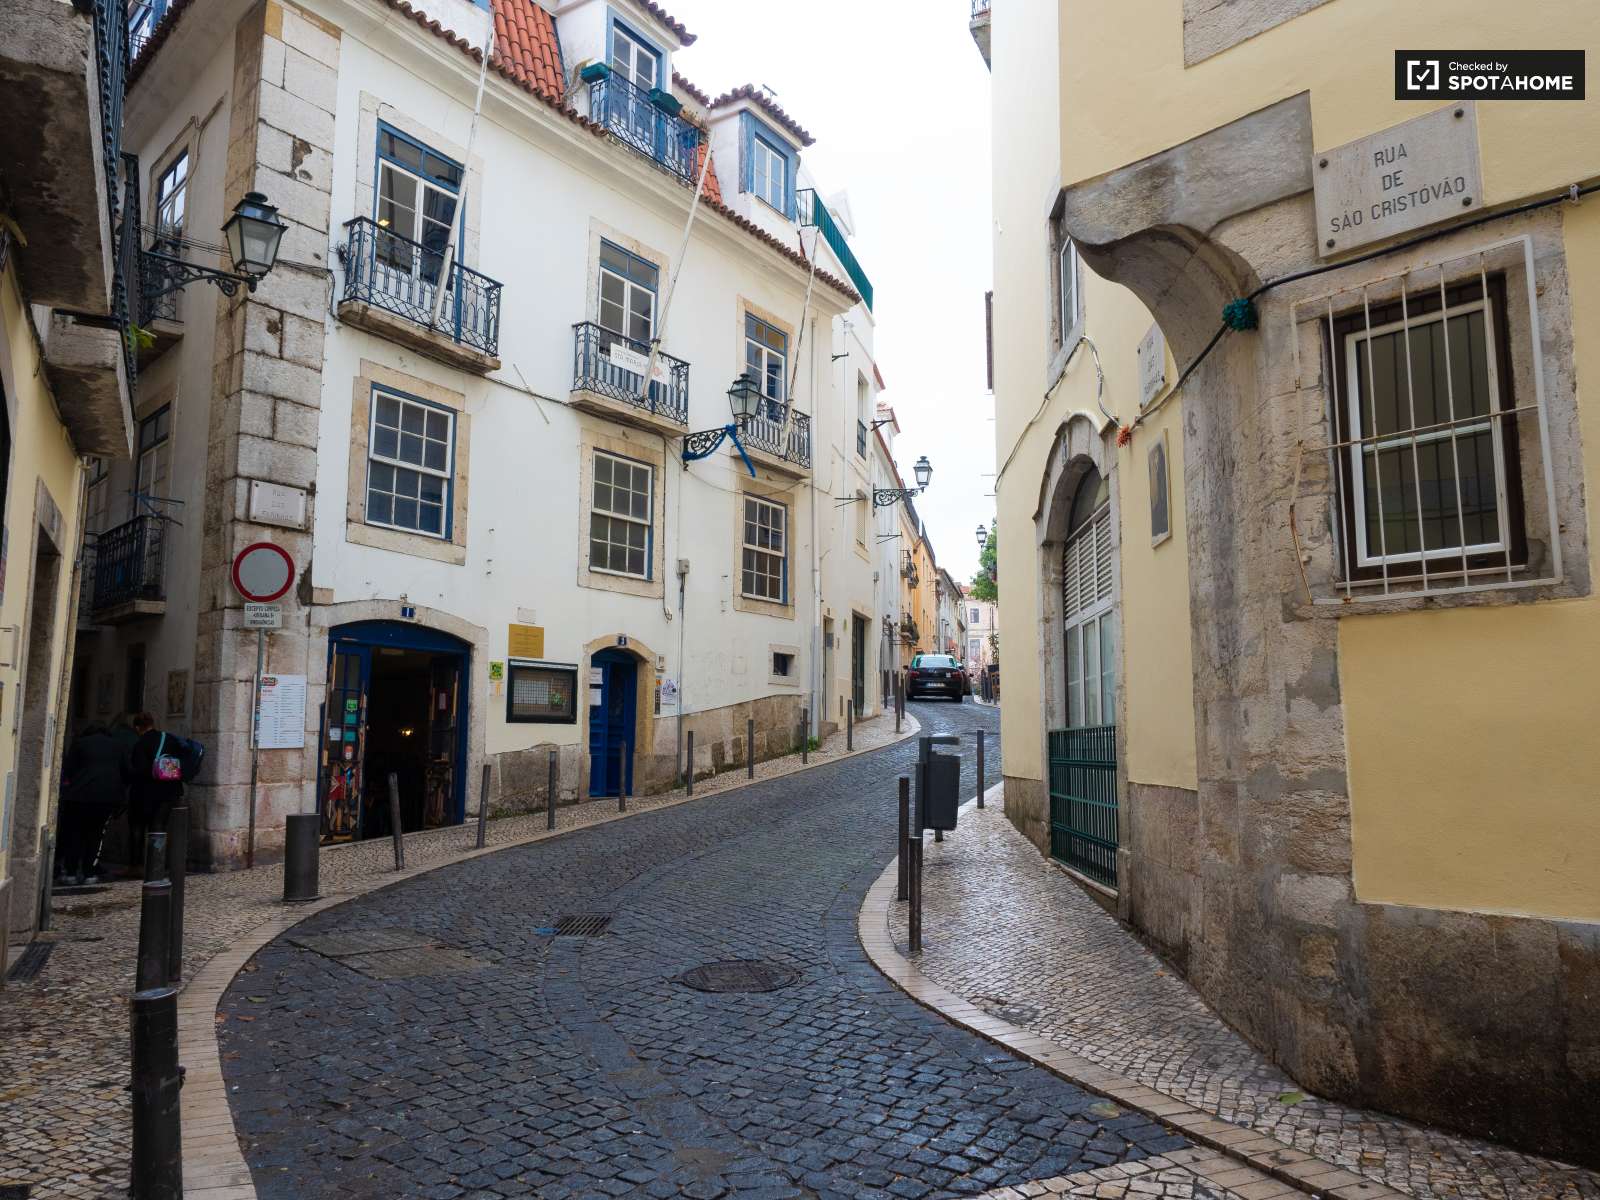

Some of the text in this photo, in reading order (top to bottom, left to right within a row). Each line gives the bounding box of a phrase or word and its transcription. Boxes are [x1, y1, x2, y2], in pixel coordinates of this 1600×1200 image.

[1374, 143, 1408, 168] RUA
[1382, 170, 1405, 191] DE
[1371, 176, 1466, 220] CRISTÓVÃO
[1330, 210, 1363, 233] SÃO
